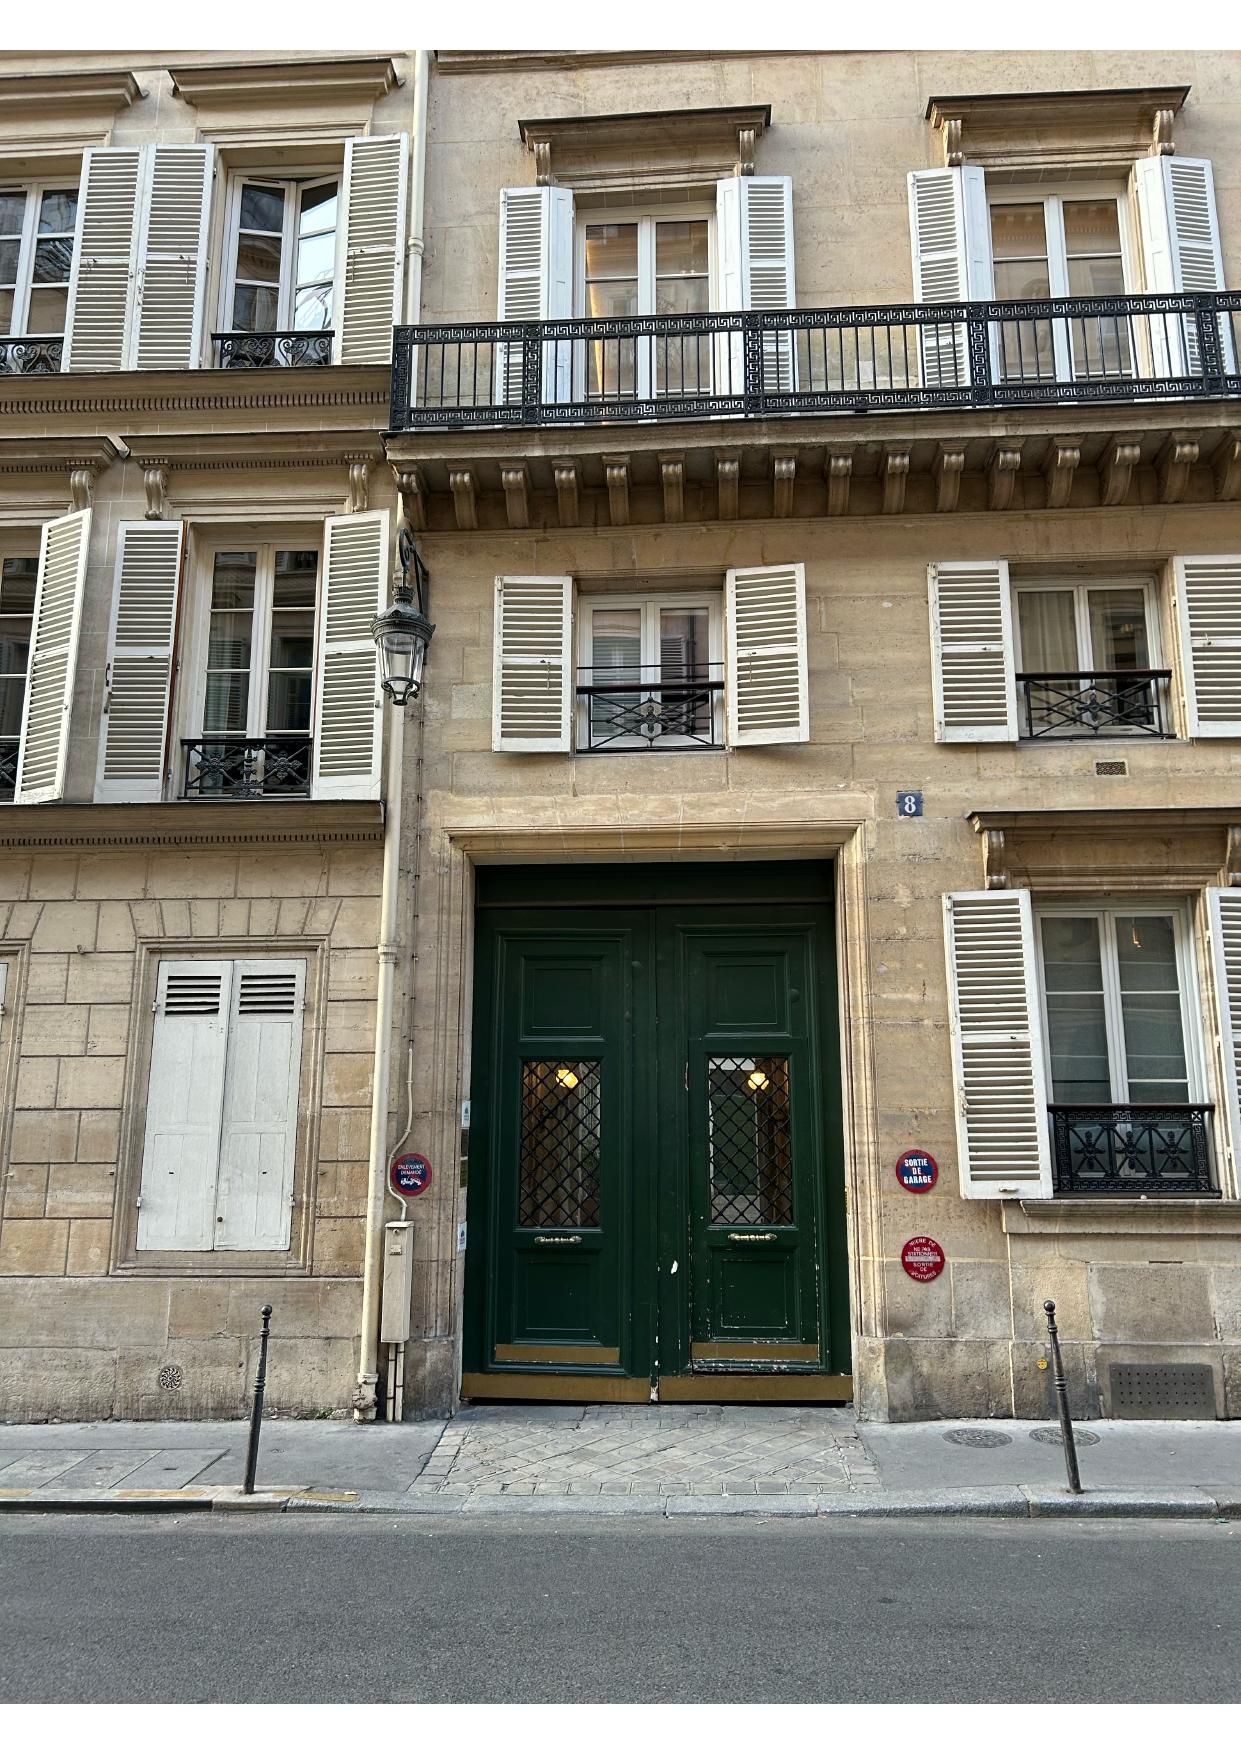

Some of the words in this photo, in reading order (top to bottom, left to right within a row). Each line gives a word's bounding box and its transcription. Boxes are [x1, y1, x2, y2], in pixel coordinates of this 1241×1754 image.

[904, 795, 916, 814] 8
[904, 1158, 928, 1167] SORTIE
[912, 1167, 922, 1175] DE
[903, 1175, 933, 1184] GARAGE
